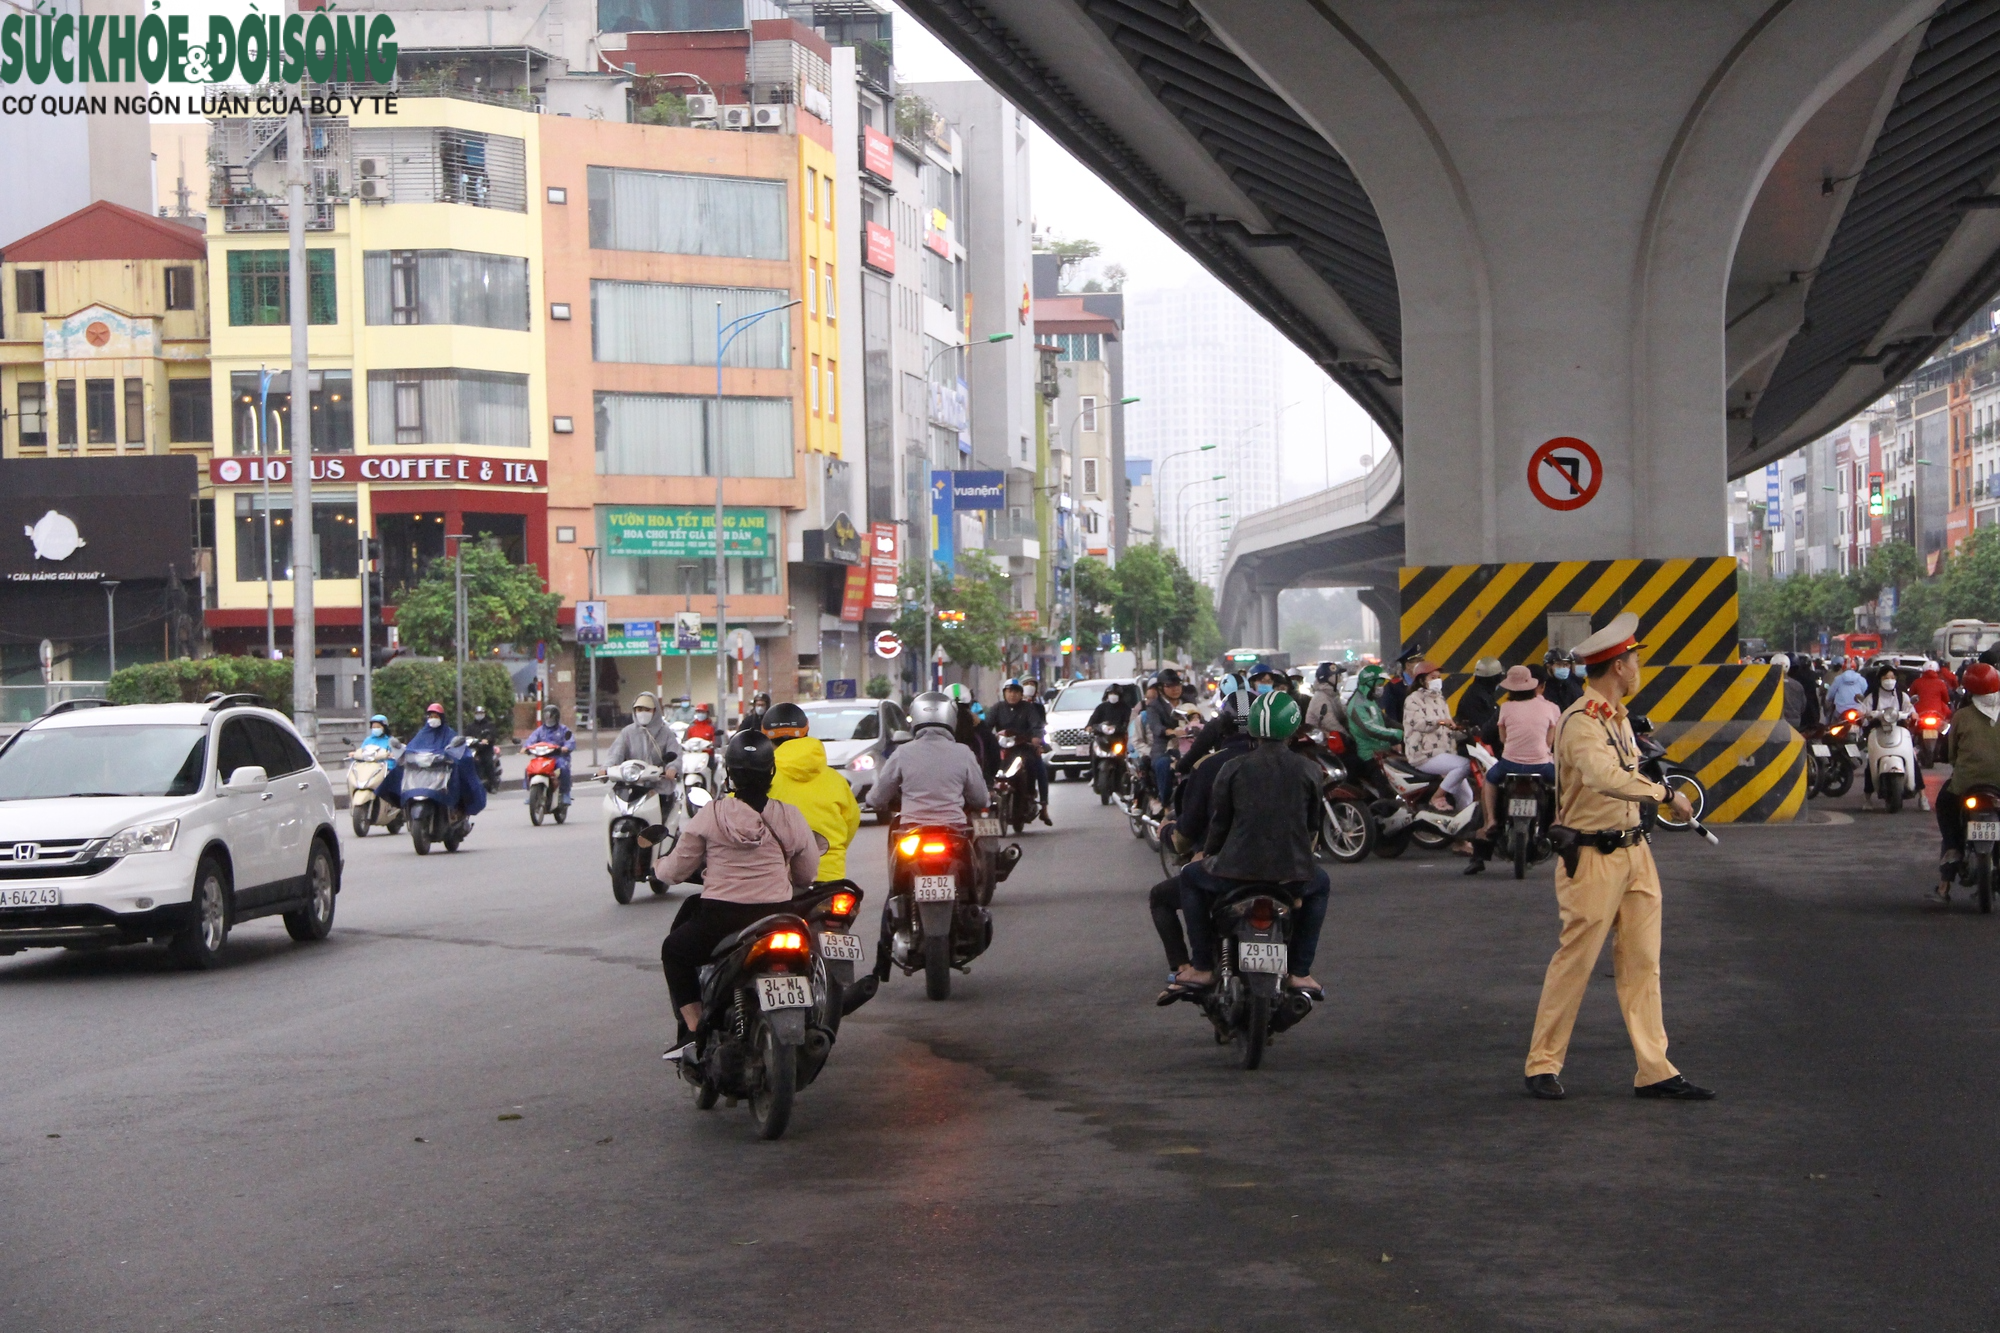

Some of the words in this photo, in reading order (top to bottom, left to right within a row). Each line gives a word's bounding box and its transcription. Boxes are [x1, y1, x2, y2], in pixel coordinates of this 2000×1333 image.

[360, 458, 470, 480] COFFEE
[480, 461, 494, 481] &
[503, 462, 538, 483] TEA
[609, 512, 645, 526] VƯỜN
[648, 515, 674, 527] HOA
[676, 511, 699, 527] TẾT
[739, 516, 765, 528] ANH
[623, 529, 644, 539] HOA
[670, 528, 687, 540] TẾT
[689, 529, 705, 540] GIÁ
[731, 529, 752, 541] DÂN
[919, 888, 952, 900] 399.32
[824, 946, 860, 959] 036.87
[767, 991, 806, 1008] 0409
